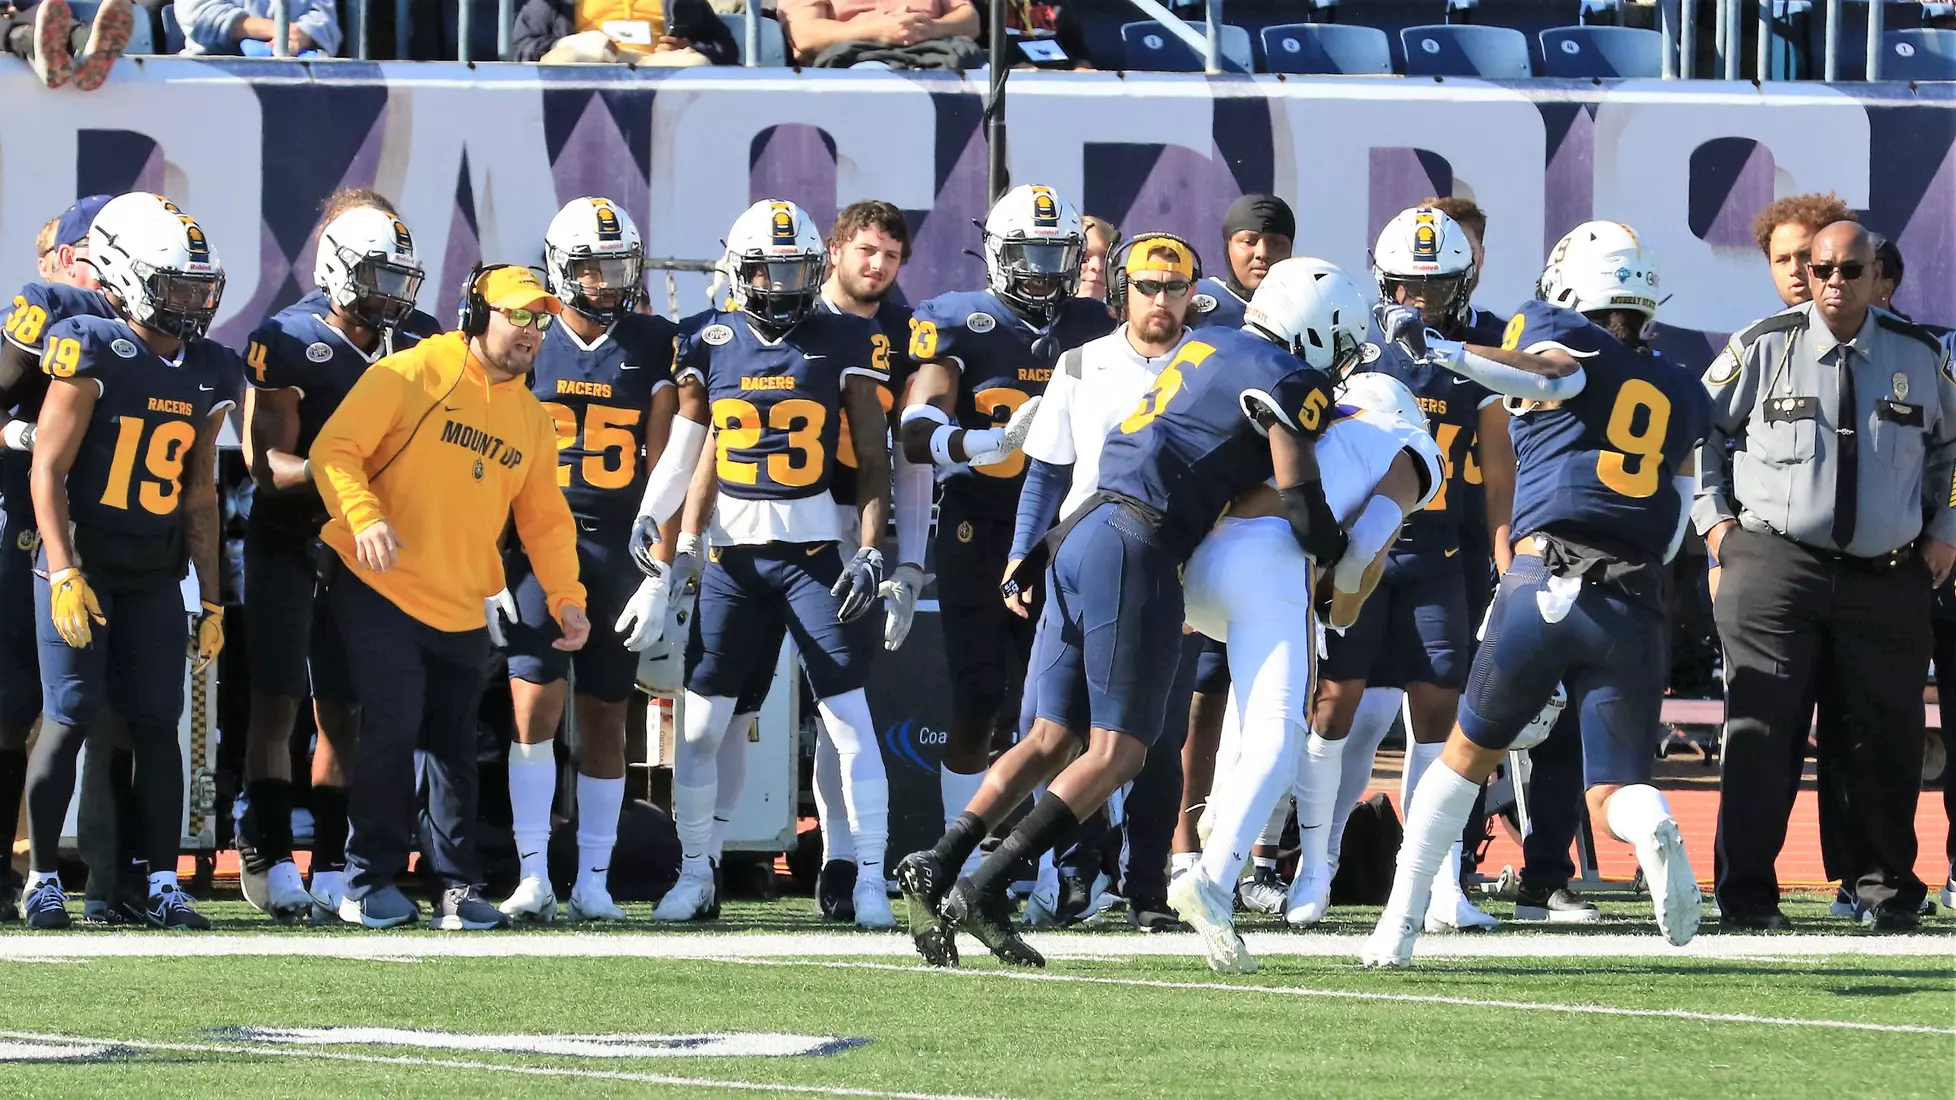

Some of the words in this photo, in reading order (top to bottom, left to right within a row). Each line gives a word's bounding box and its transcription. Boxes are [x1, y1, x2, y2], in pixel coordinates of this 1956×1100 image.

[189, 263, 212, 271] Riddell
[5, 295, 47, 344] 38
[1501, 313, 1526, 351] 9
[43, 336, 81, 377] 19
[247, 340, 267, 382] 4
[870, 333, 890, 370] 2
[556, 379, 612, 398] RACERS
[741, 376, 795, 391] RACERS
[1018, 368, 1055, 382] RACE
[1120, 340, 1217, 434] 5
[147, 397, 193, 416] RACERS
[1298, 388, 1329, 431] 5
[1416, 397, 1447, 415] ERS
[440, 419, 504, 460] MOUNT
[499, 446, 523, 469] UP
[712, 398, 827, 487] 23
[974, 387, 1030, 479] 3
[1597, 378, 1672, 498] 9
[99, 415, 196, 515] 19
[919, 726, 948, 744] Coa
